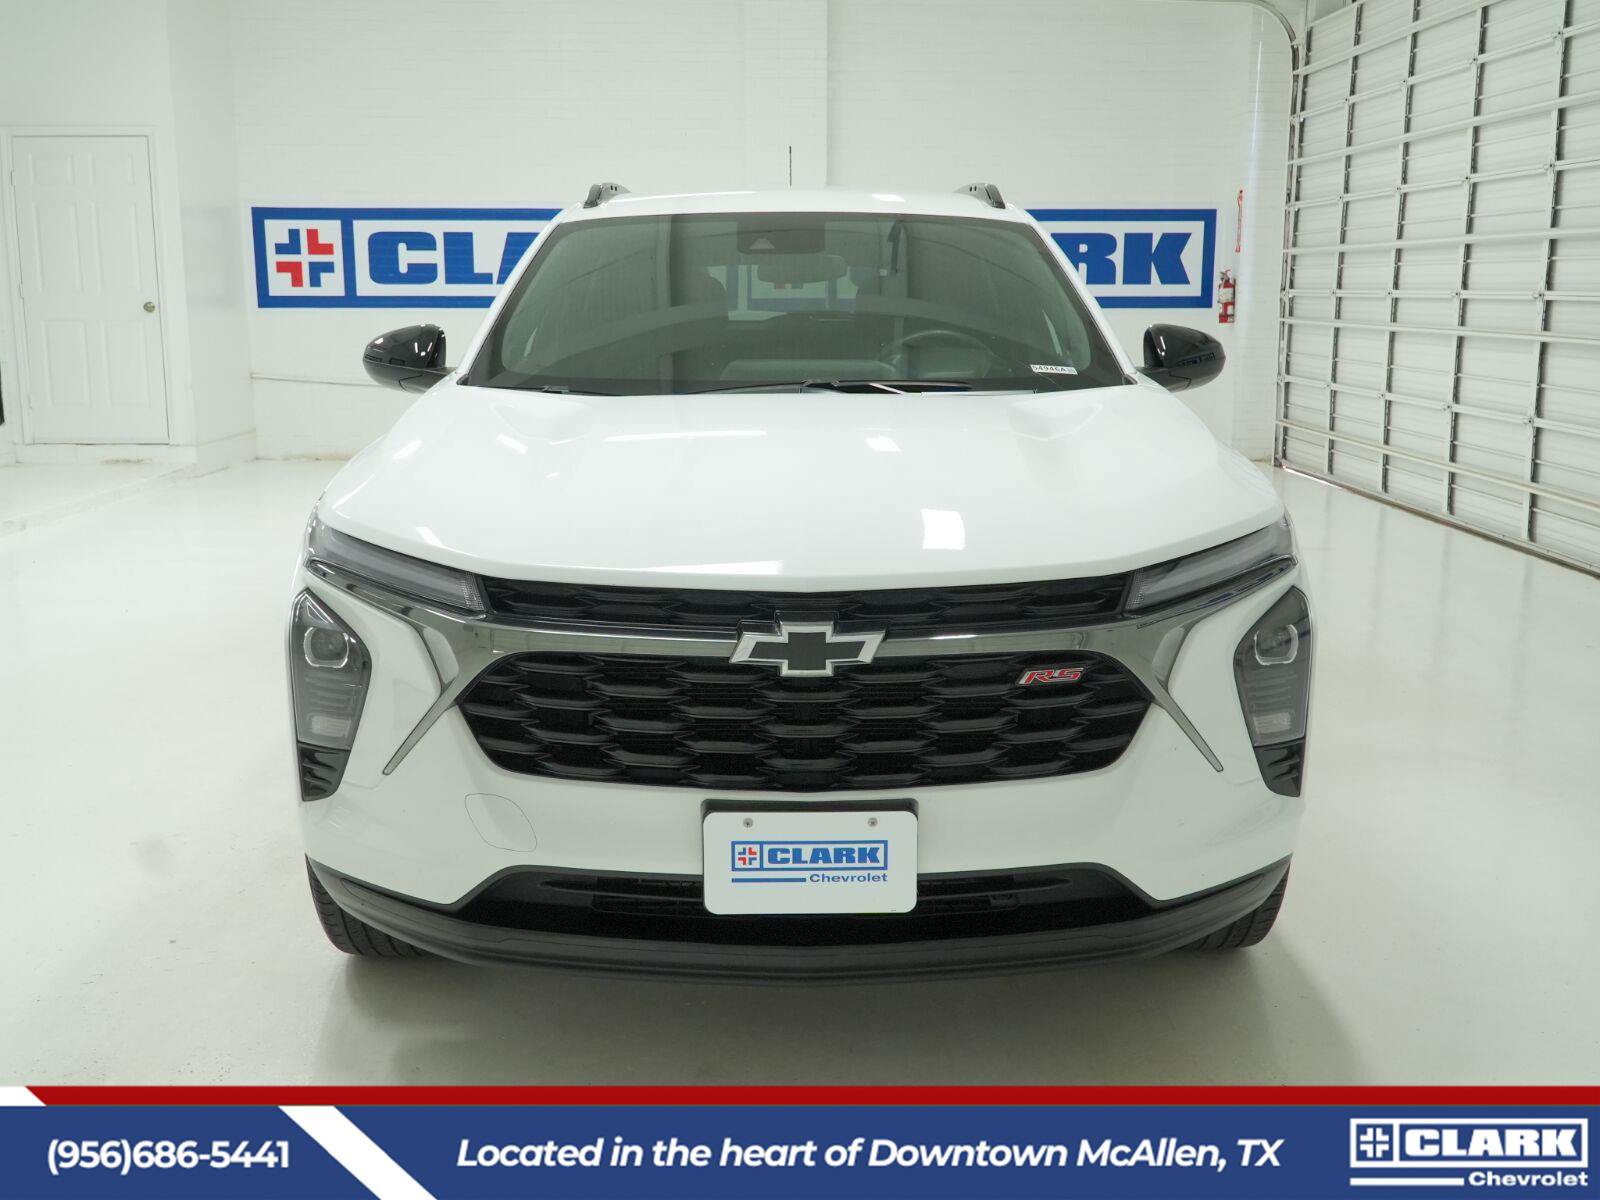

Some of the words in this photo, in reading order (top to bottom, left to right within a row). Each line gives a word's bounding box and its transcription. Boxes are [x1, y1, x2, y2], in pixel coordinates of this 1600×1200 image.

[1018, 666, 1084, 685] RS
[767, 847, 881, 865] CLARK
[809, 872, 888, 883] Chevrolet
